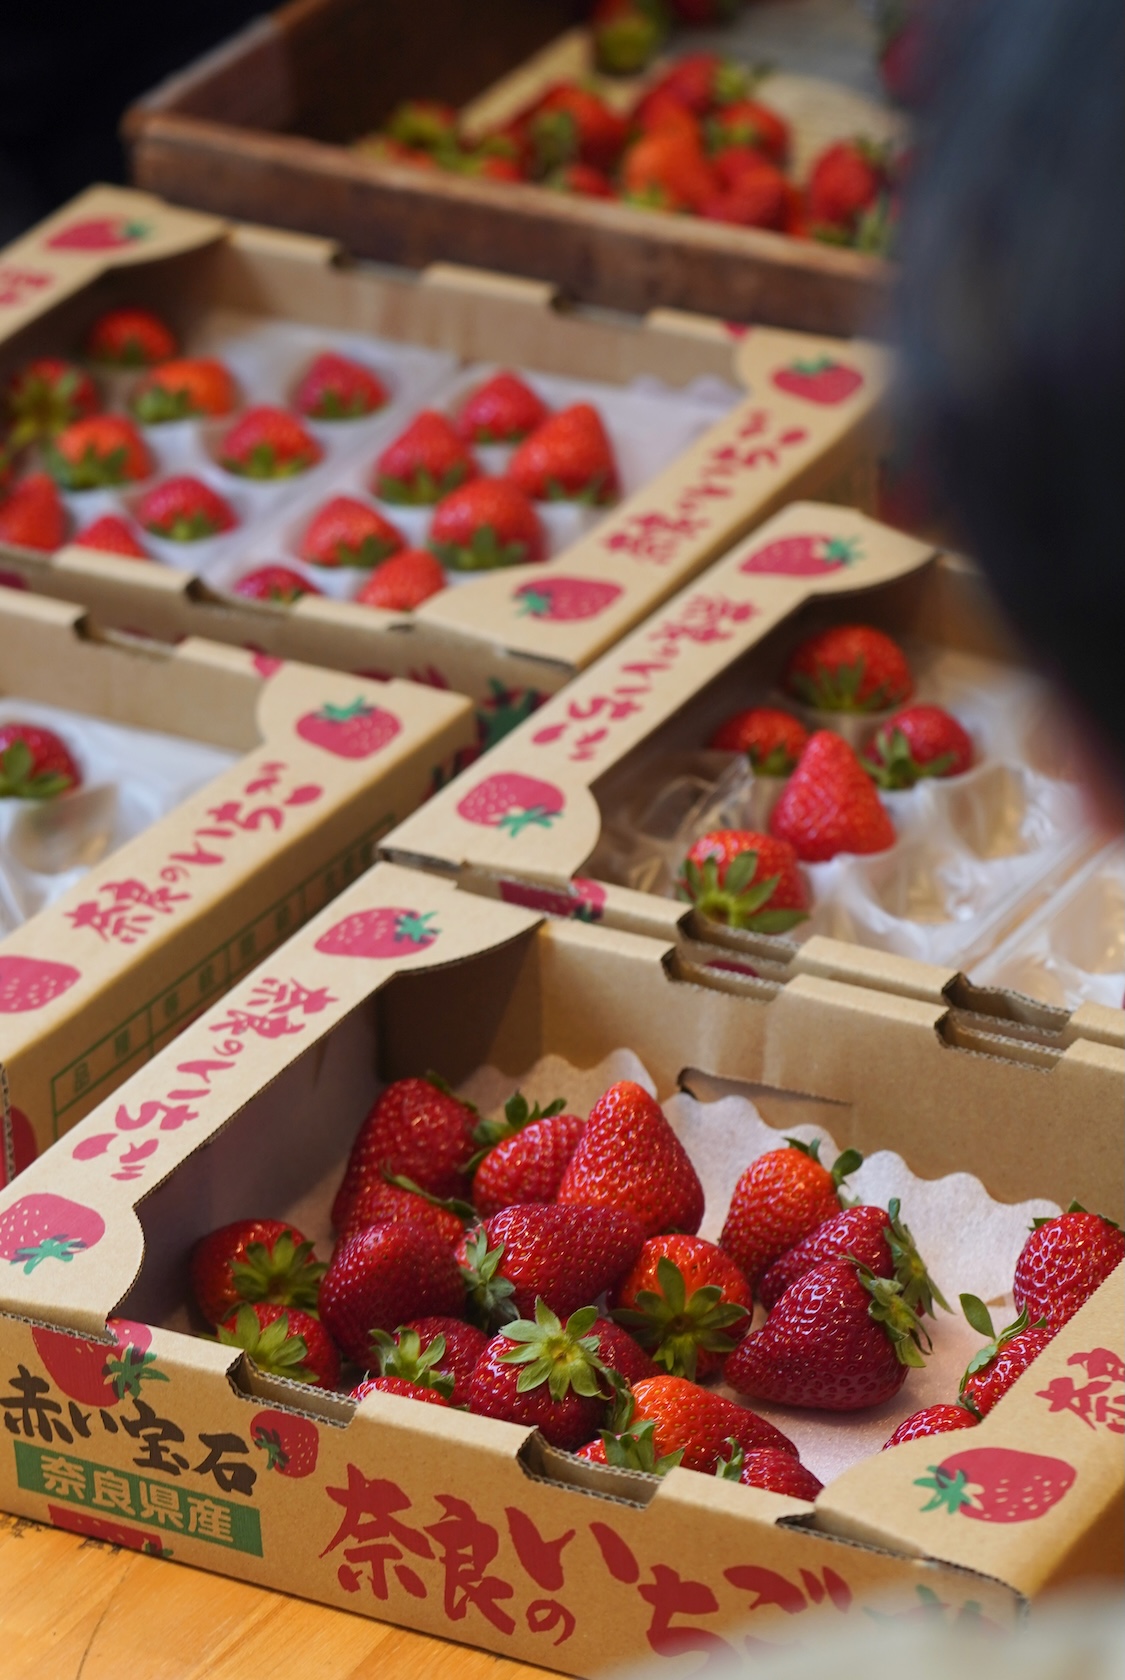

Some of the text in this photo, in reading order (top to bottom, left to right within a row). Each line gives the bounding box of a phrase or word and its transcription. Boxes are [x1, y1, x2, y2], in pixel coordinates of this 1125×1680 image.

[63, 761, 324, 944] 奈良のいちご
[72, 977, 338, 1181] 奈良のいちご
[2, 1364, 258, 1496] 赤い宝石
[40, 1454, 235, 1545] 奈良県産
